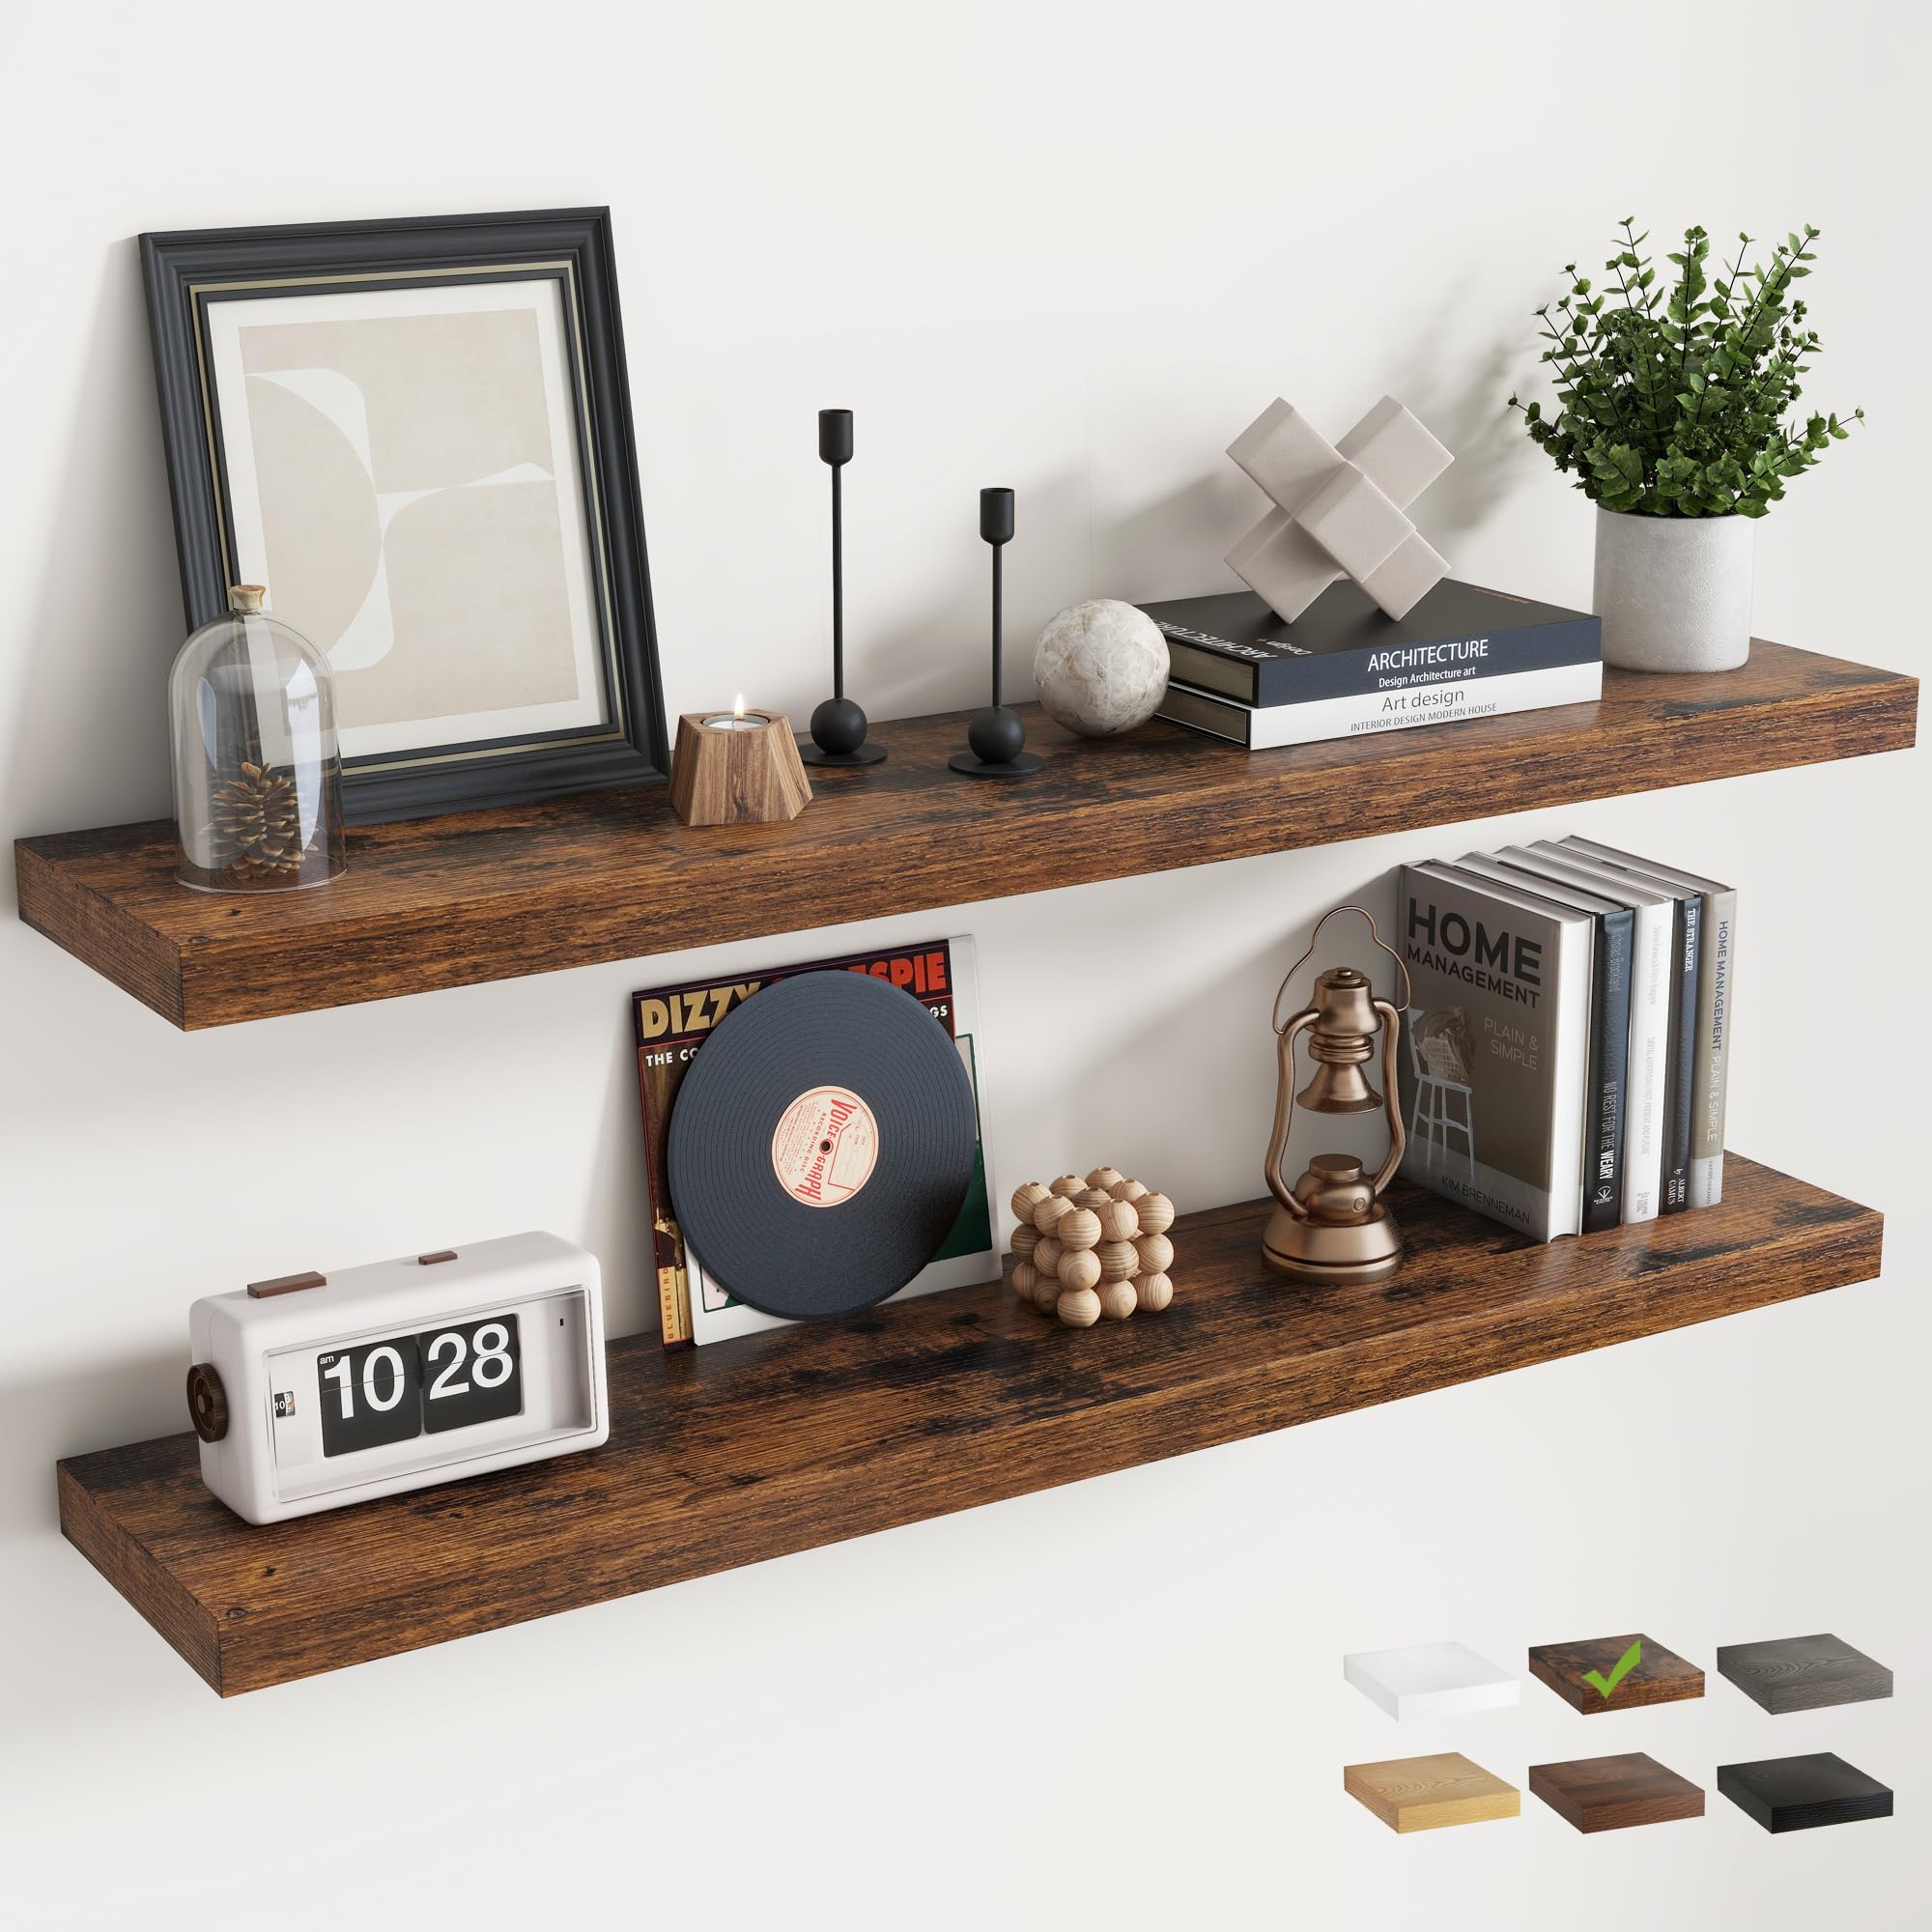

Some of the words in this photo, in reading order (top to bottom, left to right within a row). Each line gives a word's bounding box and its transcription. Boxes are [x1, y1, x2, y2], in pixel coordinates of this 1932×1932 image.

[1367, 639, 1489, 672] ARCHITECTURE
[1378, 676, 1408, 689] Design
[1409, 667, 1463, 685] Architecture
[1463, 666, 1477, 676] art
[1381, 696, 1407, 713] Art
[1411, 690, 1465, 708] design
[1350, 718, 1392, 732] INTERIOR
[1393, 713, 1426, 726] DESIGN
[1428, 707, 1466, 722] MODERN
[1468, 702, 1497, 715] HOUSE
[1688, 908, 1696, 926] THE
[1407, 896, 1543, 987] HOME
[1685, 927, 1696, 973] STRANGER
[1717, 921, 1729, 958] HOME
[1407, 942, 1541, 1009] MANAGEMENT
[1712, 960, 1725, 1051] MANAGEMENT
[1484, 1016, 1525, 1046] PLAIN
[1528, 1036, 1539, 1052] &
[645, 1051, 673, 1067] THE
[1491, 1040, 1539, 1071] SIMPLE
[1710, 1056, 1721, 1088] PLAIN
[1604, 1081, 1618, 1094] NO
[1709, 1091, 1719, 1099] &
[1602, 1094, 1617, 1115] REST
[807, 1112, 827, 1154] RECORDING
[1601, 1115, 1616, 1133] FOR
[1707, 1100, 1719, 1143] SIMPLE
[1600, 1133, 1615, 1150] THE
[799, 1156, 810, 1174] DISC
[1599, 1150, 1614, 1180] WEARY
[1440, 1174, 1460, 1191] KIM
[1462, 1184, 1531, 1224] BRENNEMAN
[1668, 1179, 1677, 1206] CAMUS
[1677, 1178, 1686, 1204] ALBERT
[663, 1267, 674, 1340] BLUEBIRD
[320, 1355, 334, 1365] am
[324, 1345, 406, 1420] 10
[428, 1322, 514, 1401] 28
